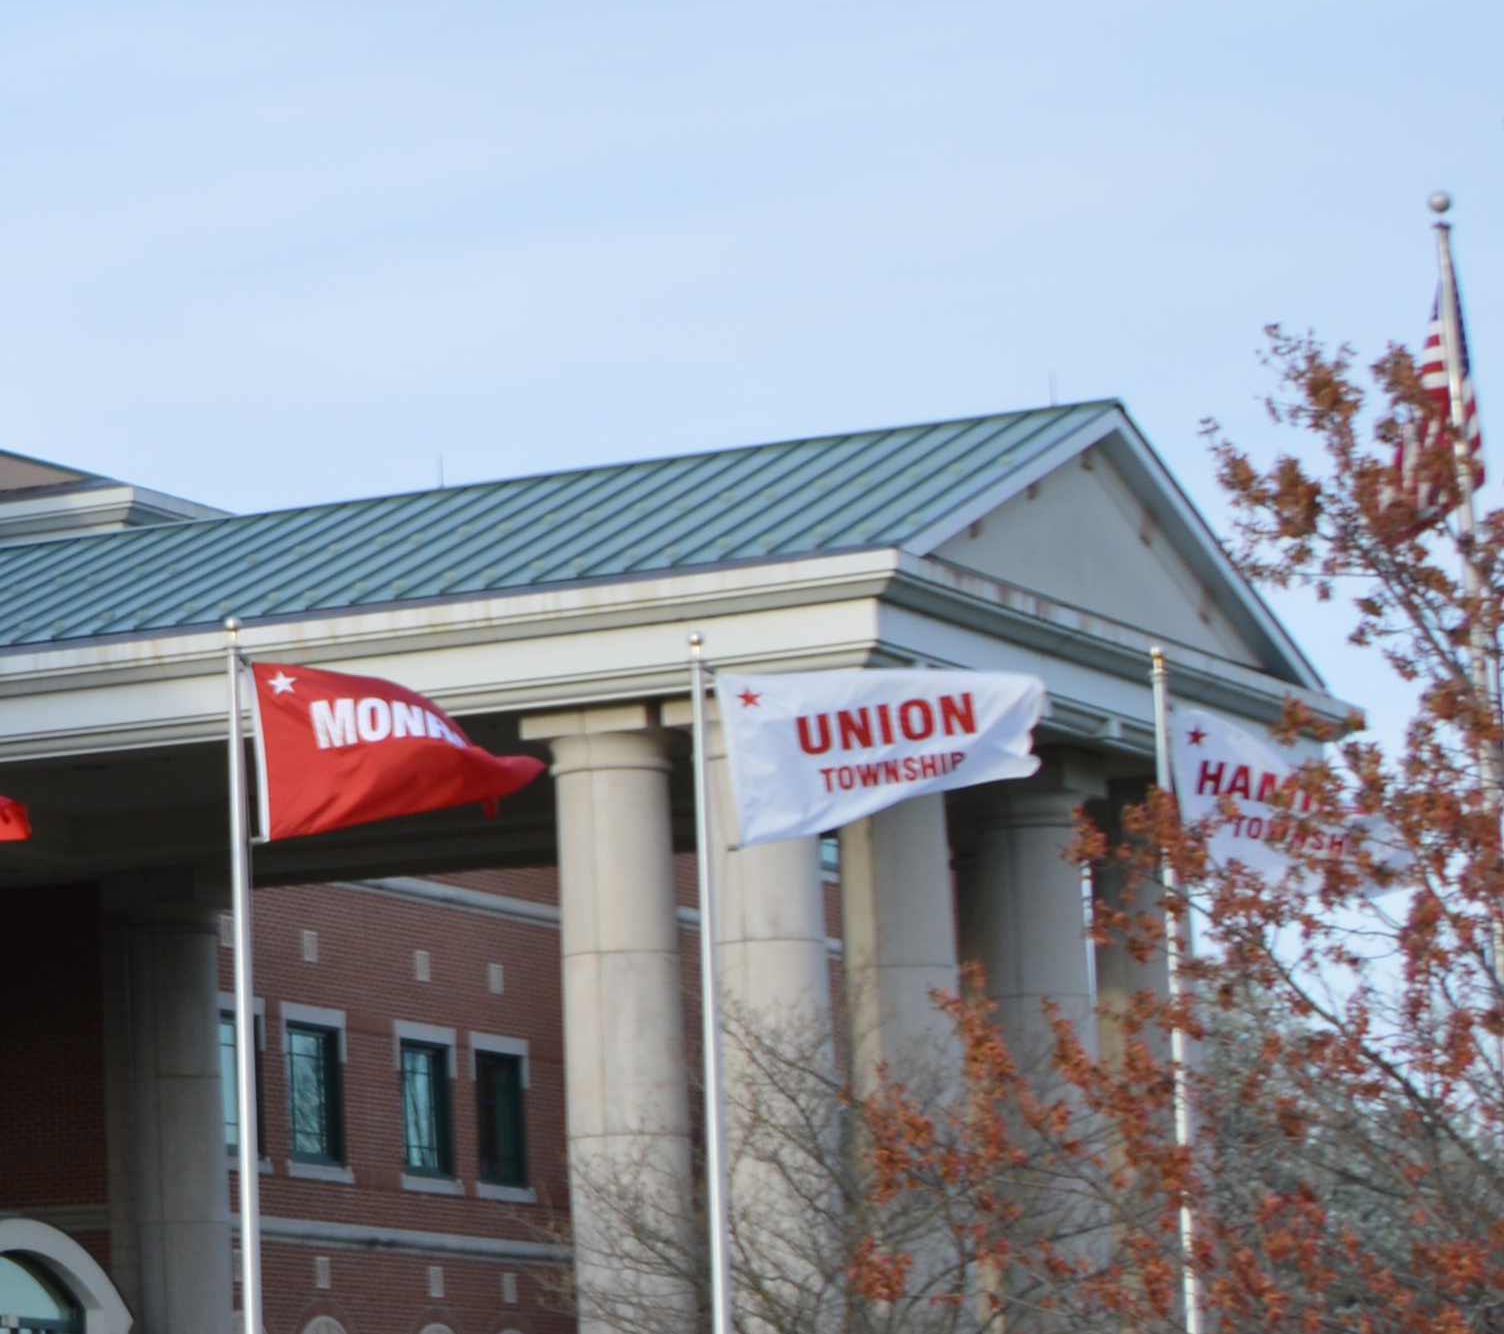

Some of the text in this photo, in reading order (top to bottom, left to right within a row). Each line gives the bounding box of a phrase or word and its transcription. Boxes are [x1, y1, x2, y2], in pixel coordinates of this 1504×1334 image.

[310, 696, 468, 750] MONR
[796, 692, 978, 757] UNION
[819, 751, 967, 793] TOWNSHIP
